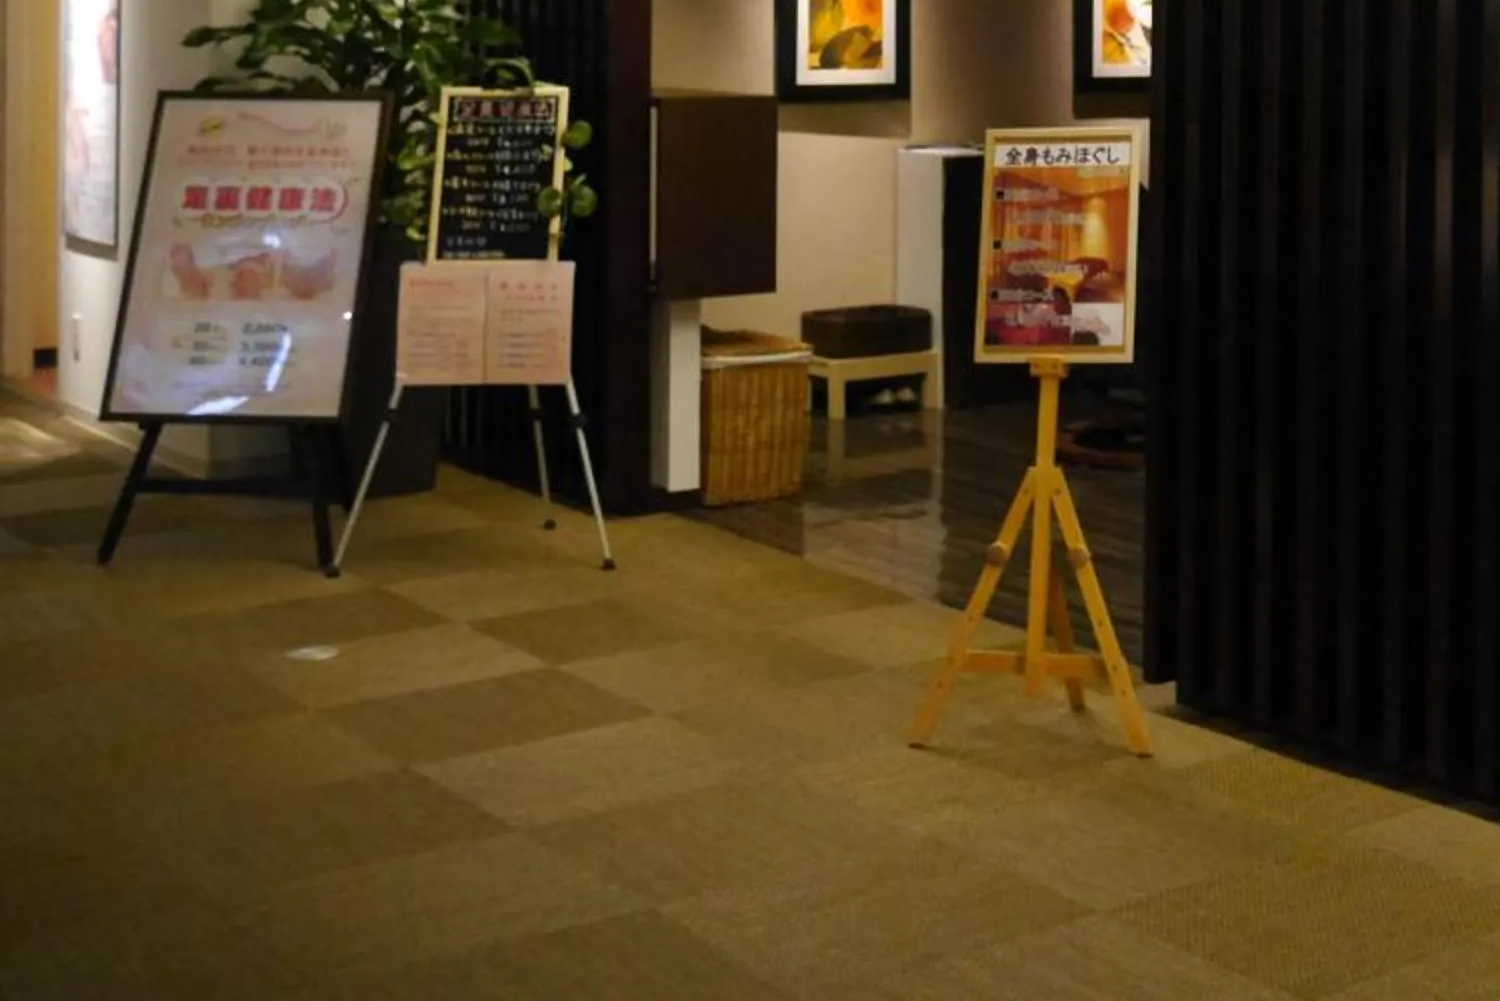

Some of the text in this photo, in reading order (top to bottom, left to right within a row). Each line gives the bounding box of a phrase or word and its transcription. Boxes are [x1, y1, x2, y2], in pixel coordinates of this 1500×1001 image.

[1005, 146, 1120, 166] 全身もみほぐし
